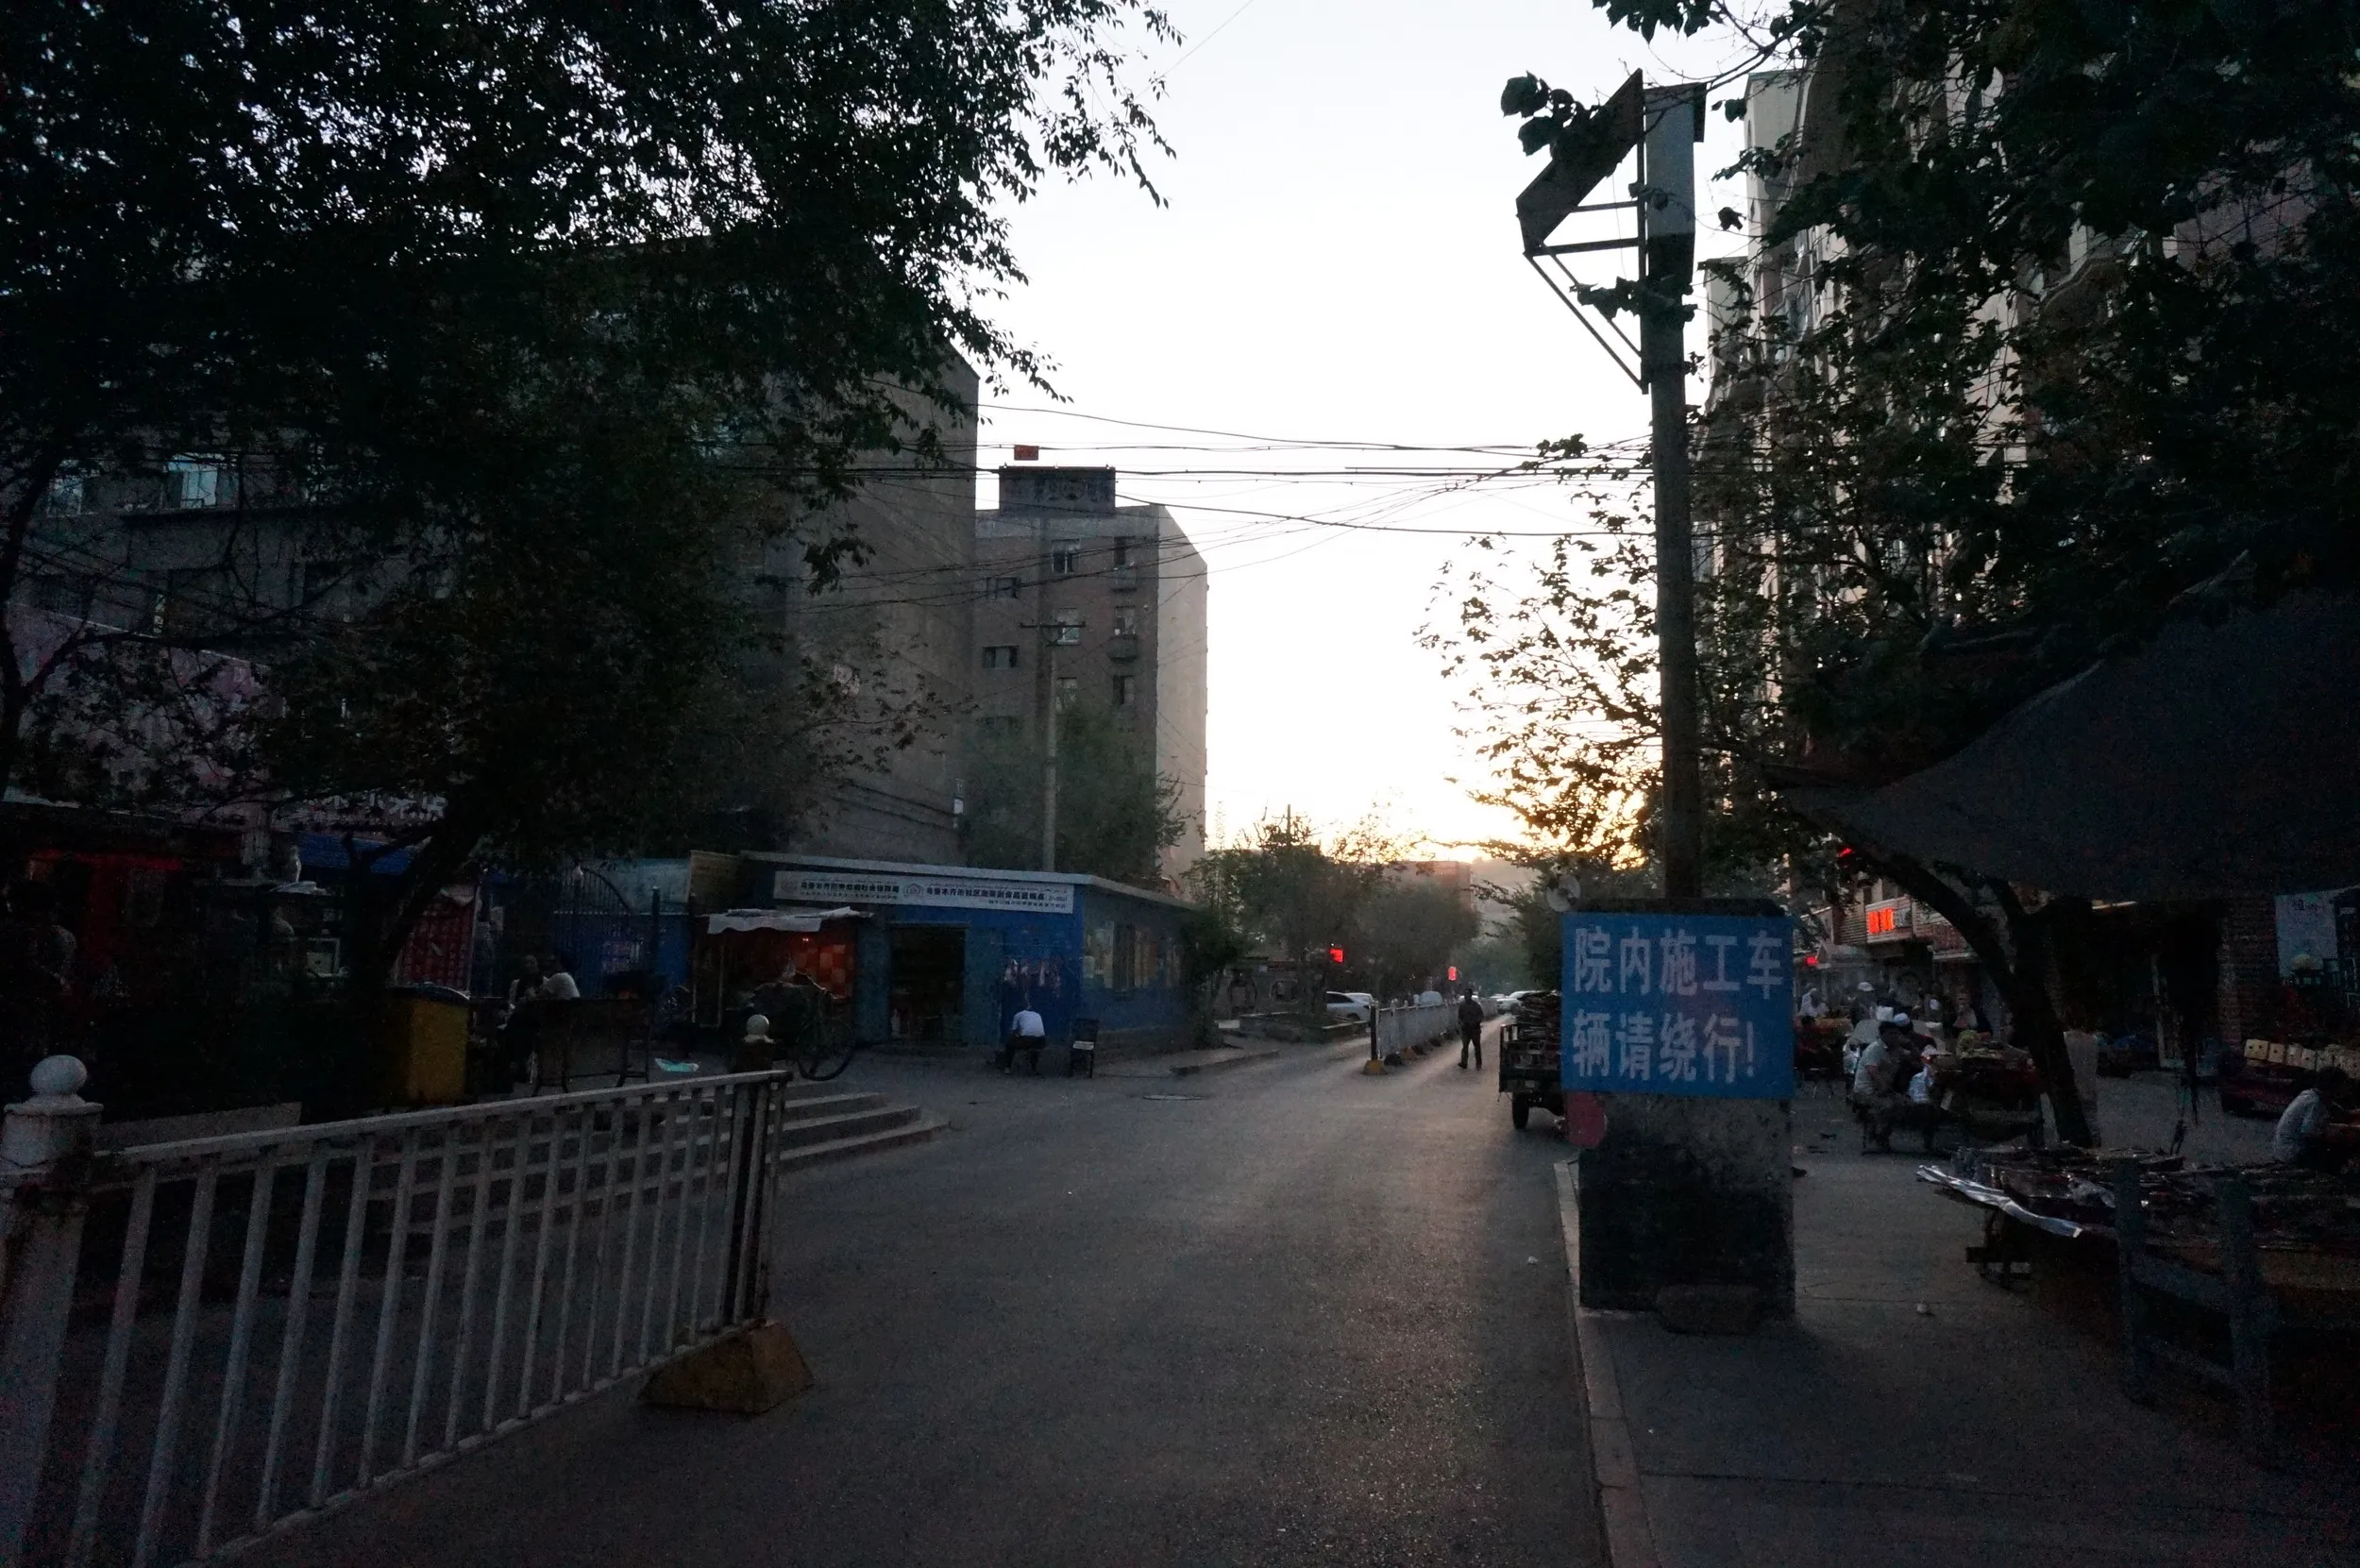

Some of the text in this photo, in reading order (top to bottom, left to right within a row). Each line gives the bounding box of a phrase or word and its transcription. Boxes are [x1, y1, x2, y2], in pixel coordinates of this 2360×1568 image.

[1574, 925, 1784, 1000] 院内施工车
